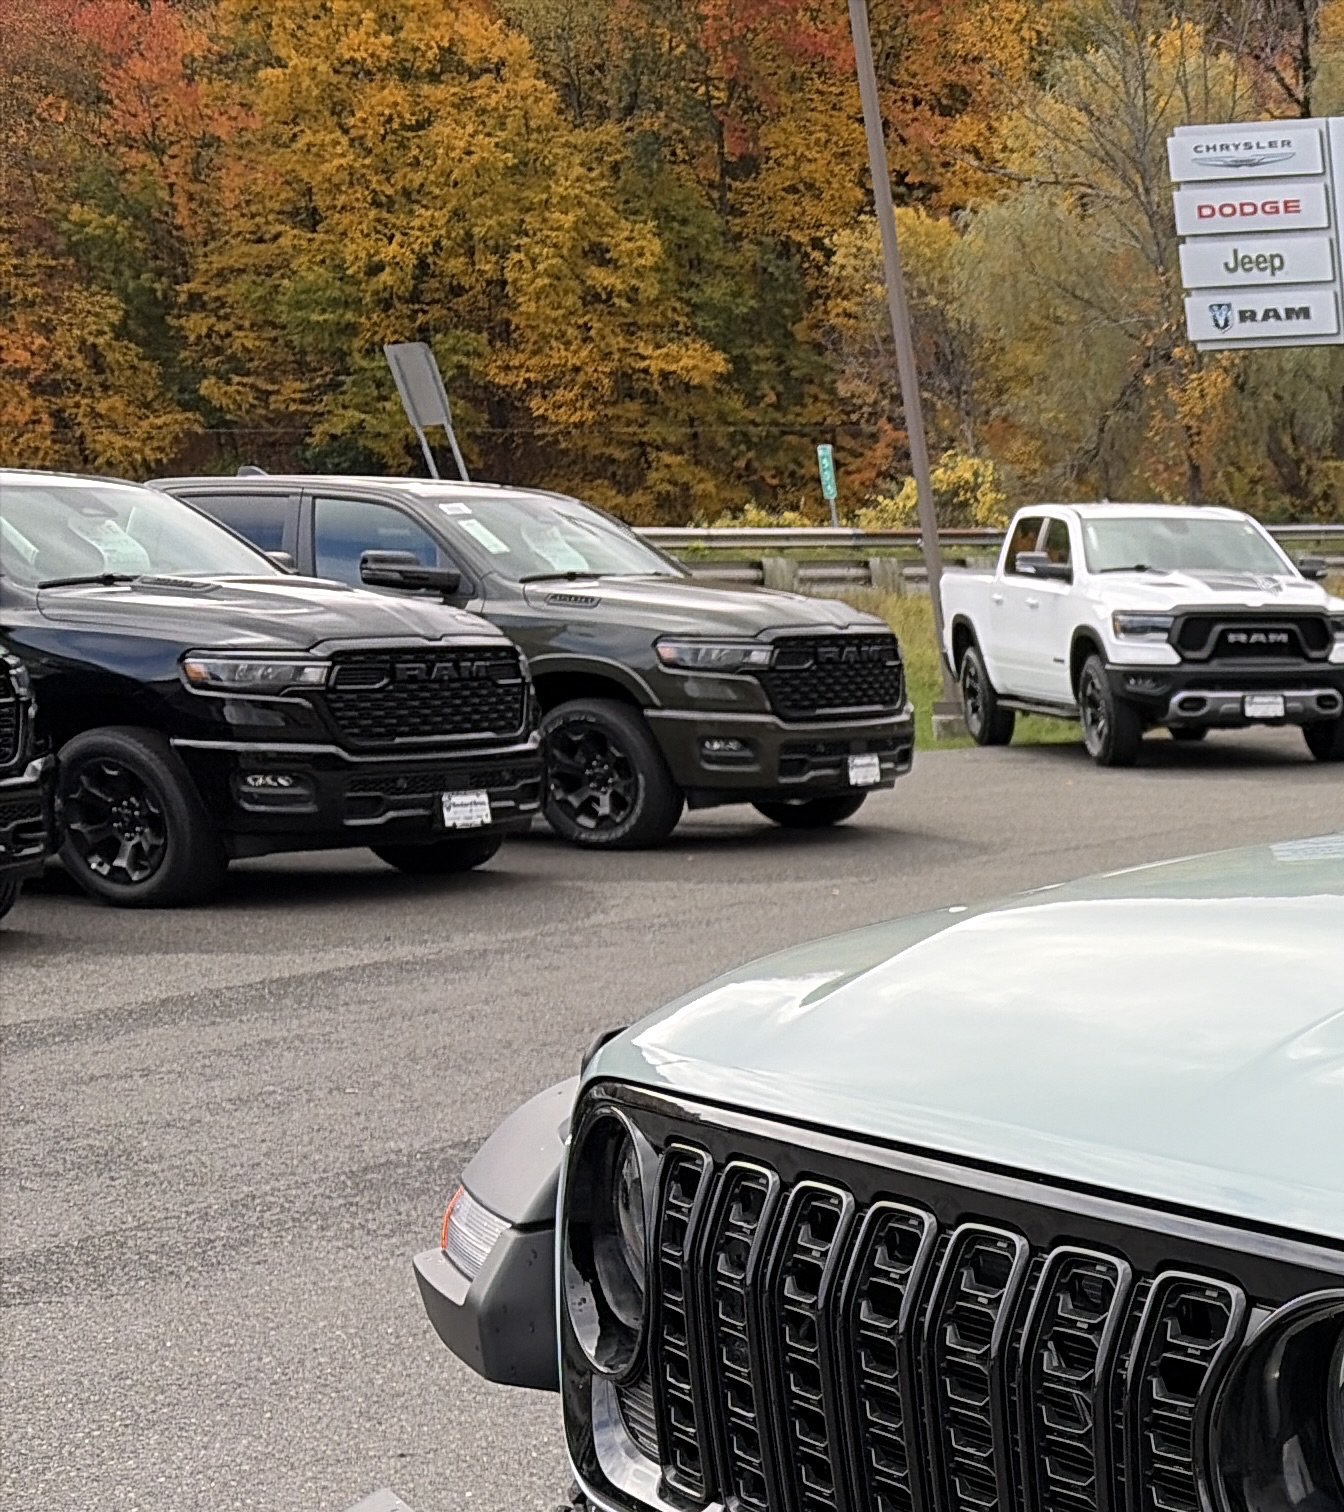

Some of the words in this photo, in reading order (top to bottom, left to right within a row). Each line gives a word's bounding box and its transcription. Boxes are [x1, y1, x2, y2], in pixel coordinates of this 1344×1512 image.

[1193, 139, 1293, 154] CHRYSLER
[1196, 199, 1302, 219] DODGE
[1224, 249, 1285, 276] Jeep
[1238, 306, 1311, 324] RAM
[1228, 632, 1289, 644] RAM
[395, 661, 491, 681] RAM
